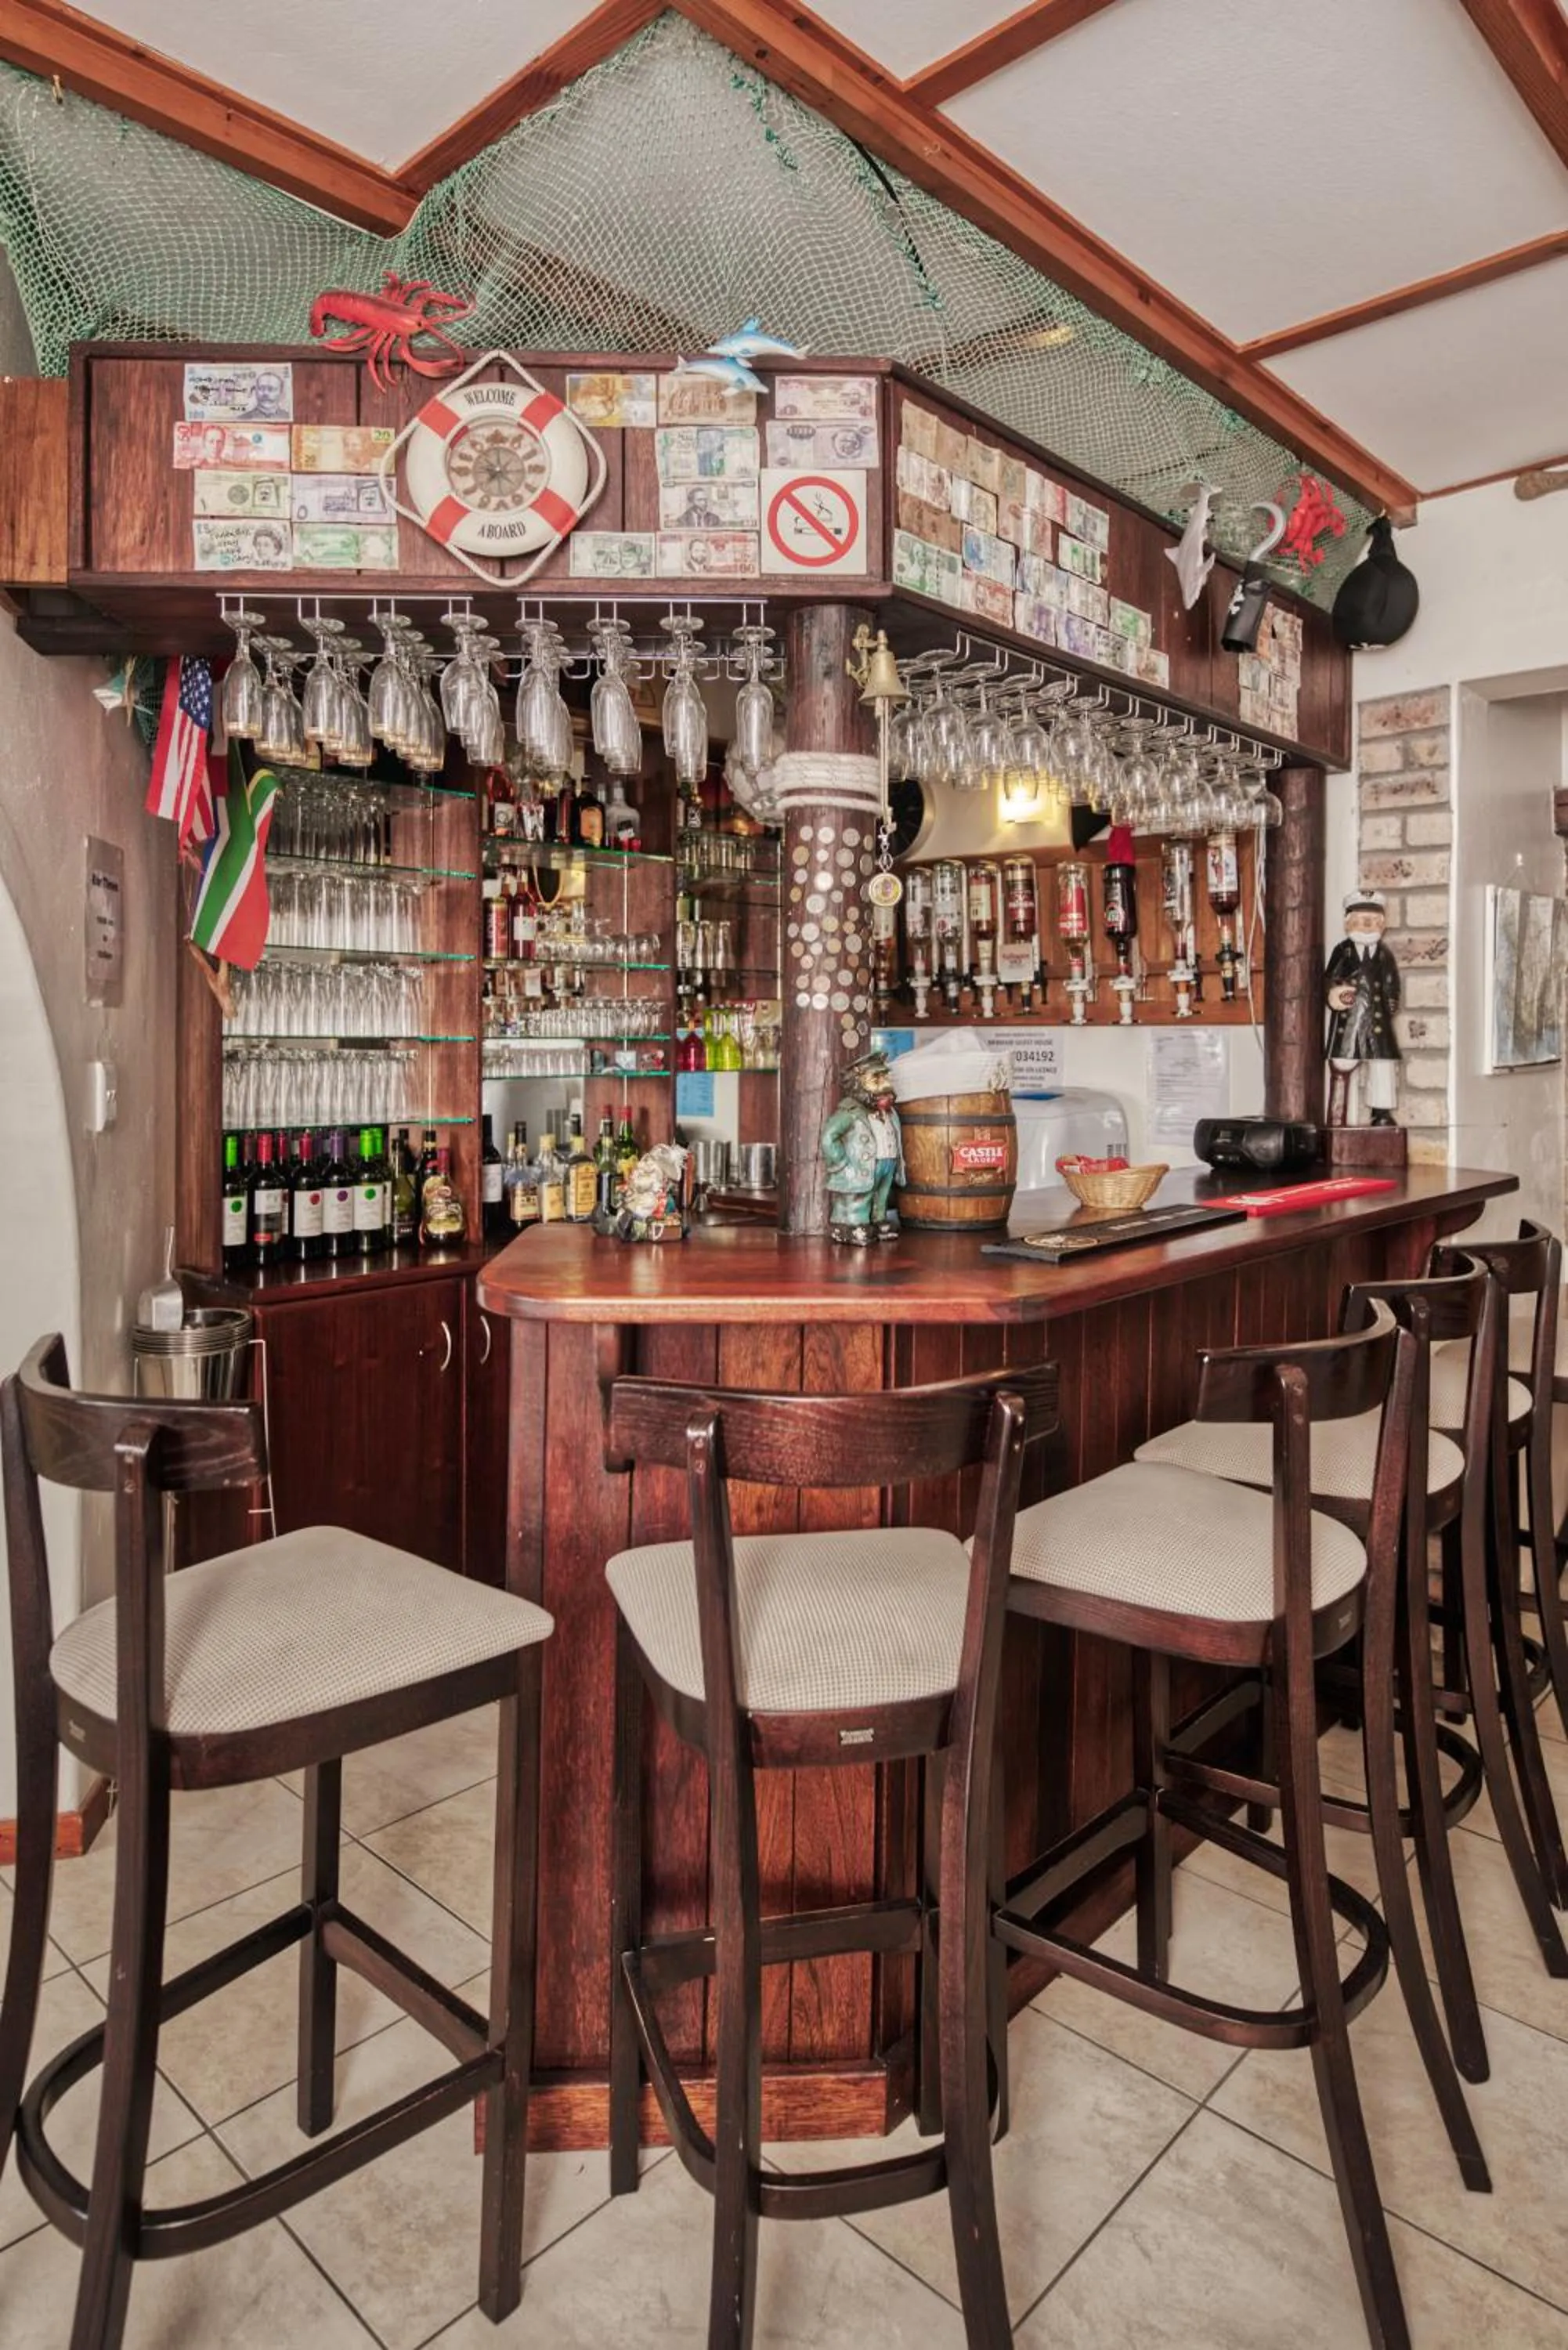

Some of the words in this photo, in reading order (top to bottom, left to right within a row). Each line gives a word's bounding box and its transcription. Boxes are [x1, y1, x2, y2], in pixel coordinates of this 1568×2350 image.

[464, 389, 515, 406] WELCOME
[374, 431, 390, 440] 20
[477, 521, 526, 539] ABOARD
[1016, 1050, 1054, 1062] 034192
[959, 1147, 1003, 1158] CASTLE
